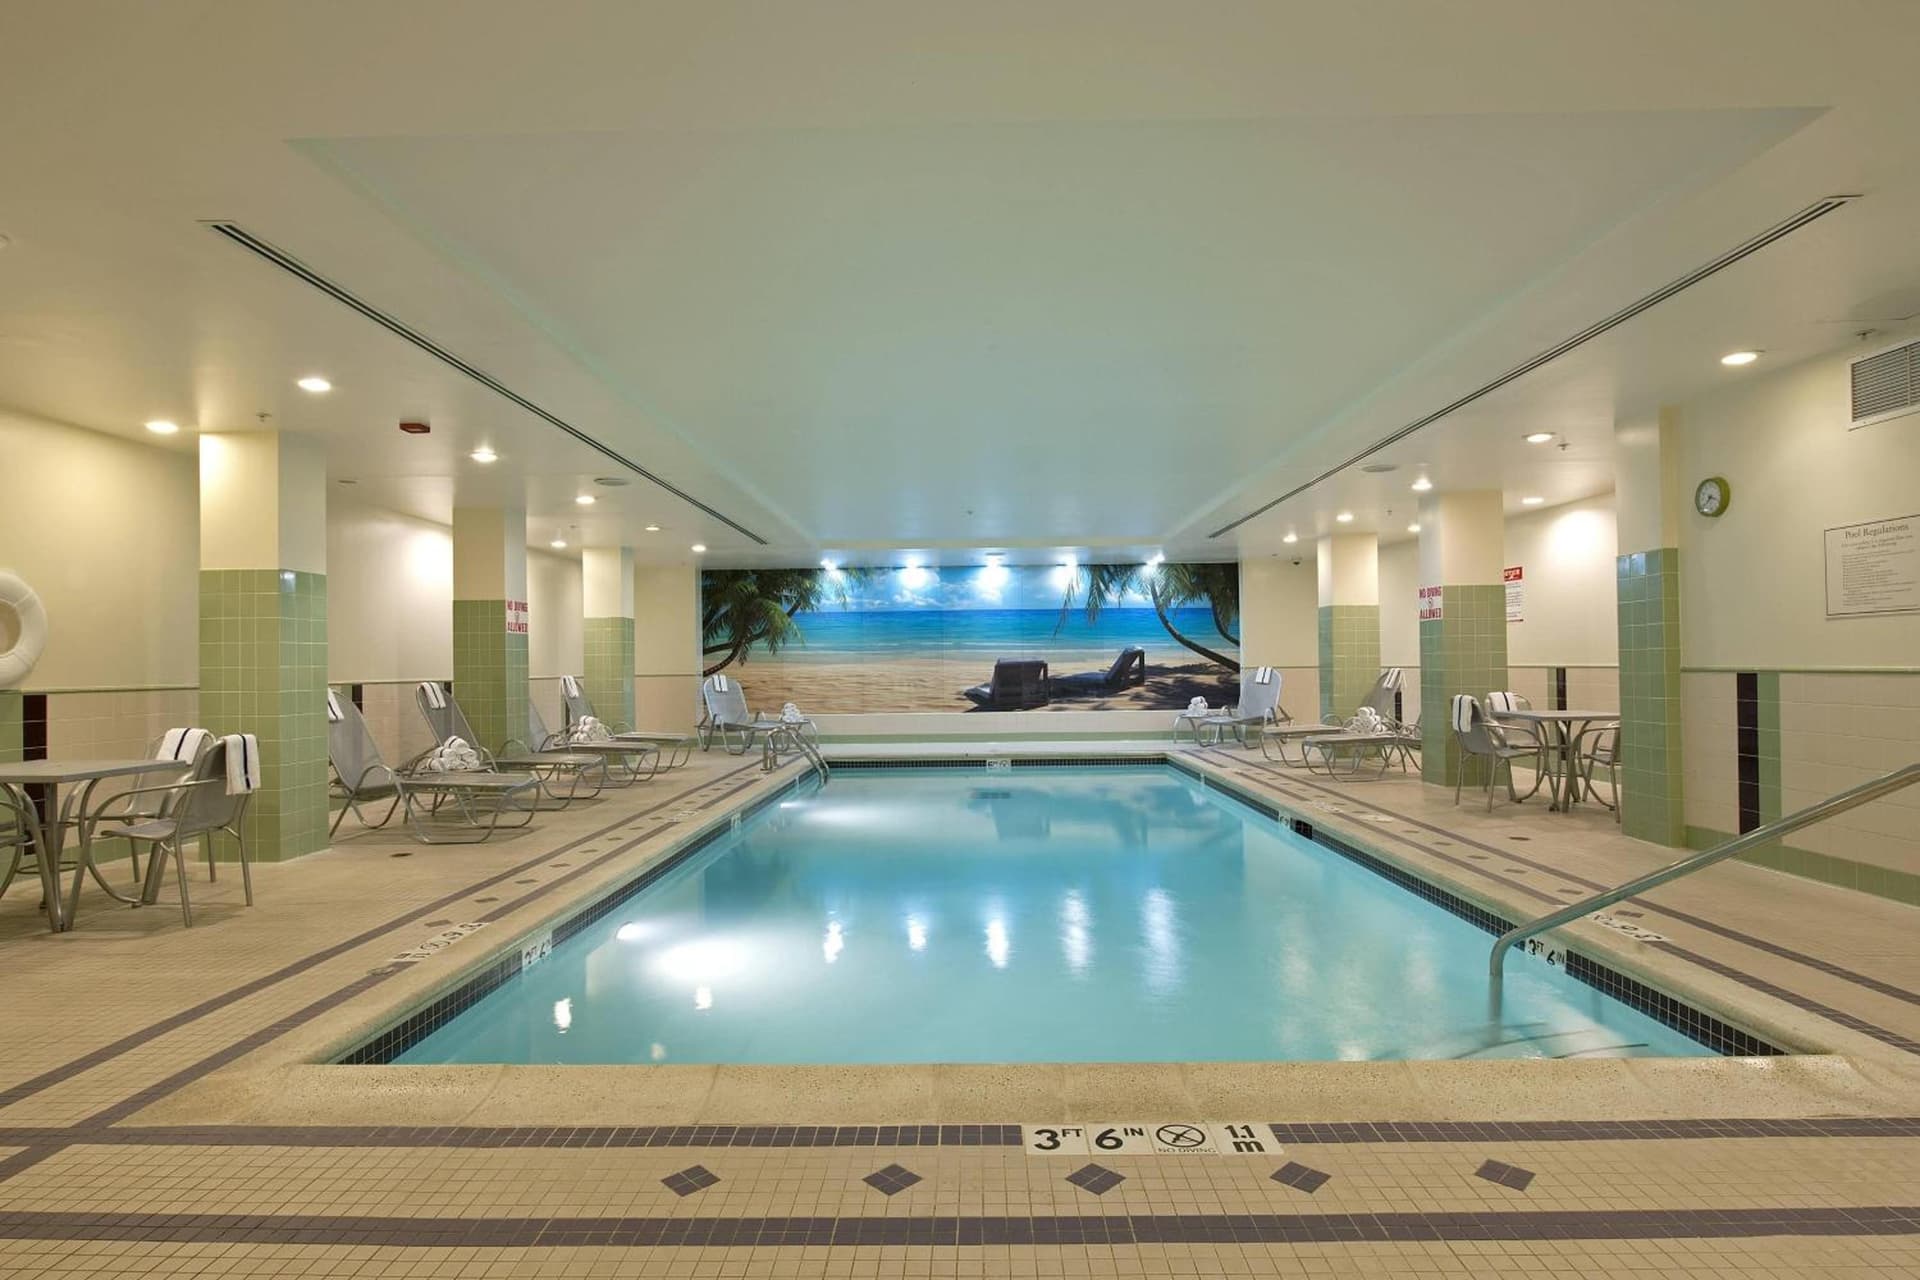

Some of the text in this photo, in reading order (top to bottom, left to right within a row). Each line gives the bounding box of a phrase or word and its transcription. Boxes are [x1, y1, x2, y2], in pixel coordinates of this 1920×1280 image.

[1844, 529, 1861, 539] Pool
[1419, 588, 1426, 598] NO
[1419, 607, 1442, 619] ALLOWED
[1224, 1124, 1256, 1139] 1.1
[1232, 1141, 1265, 1153] m
